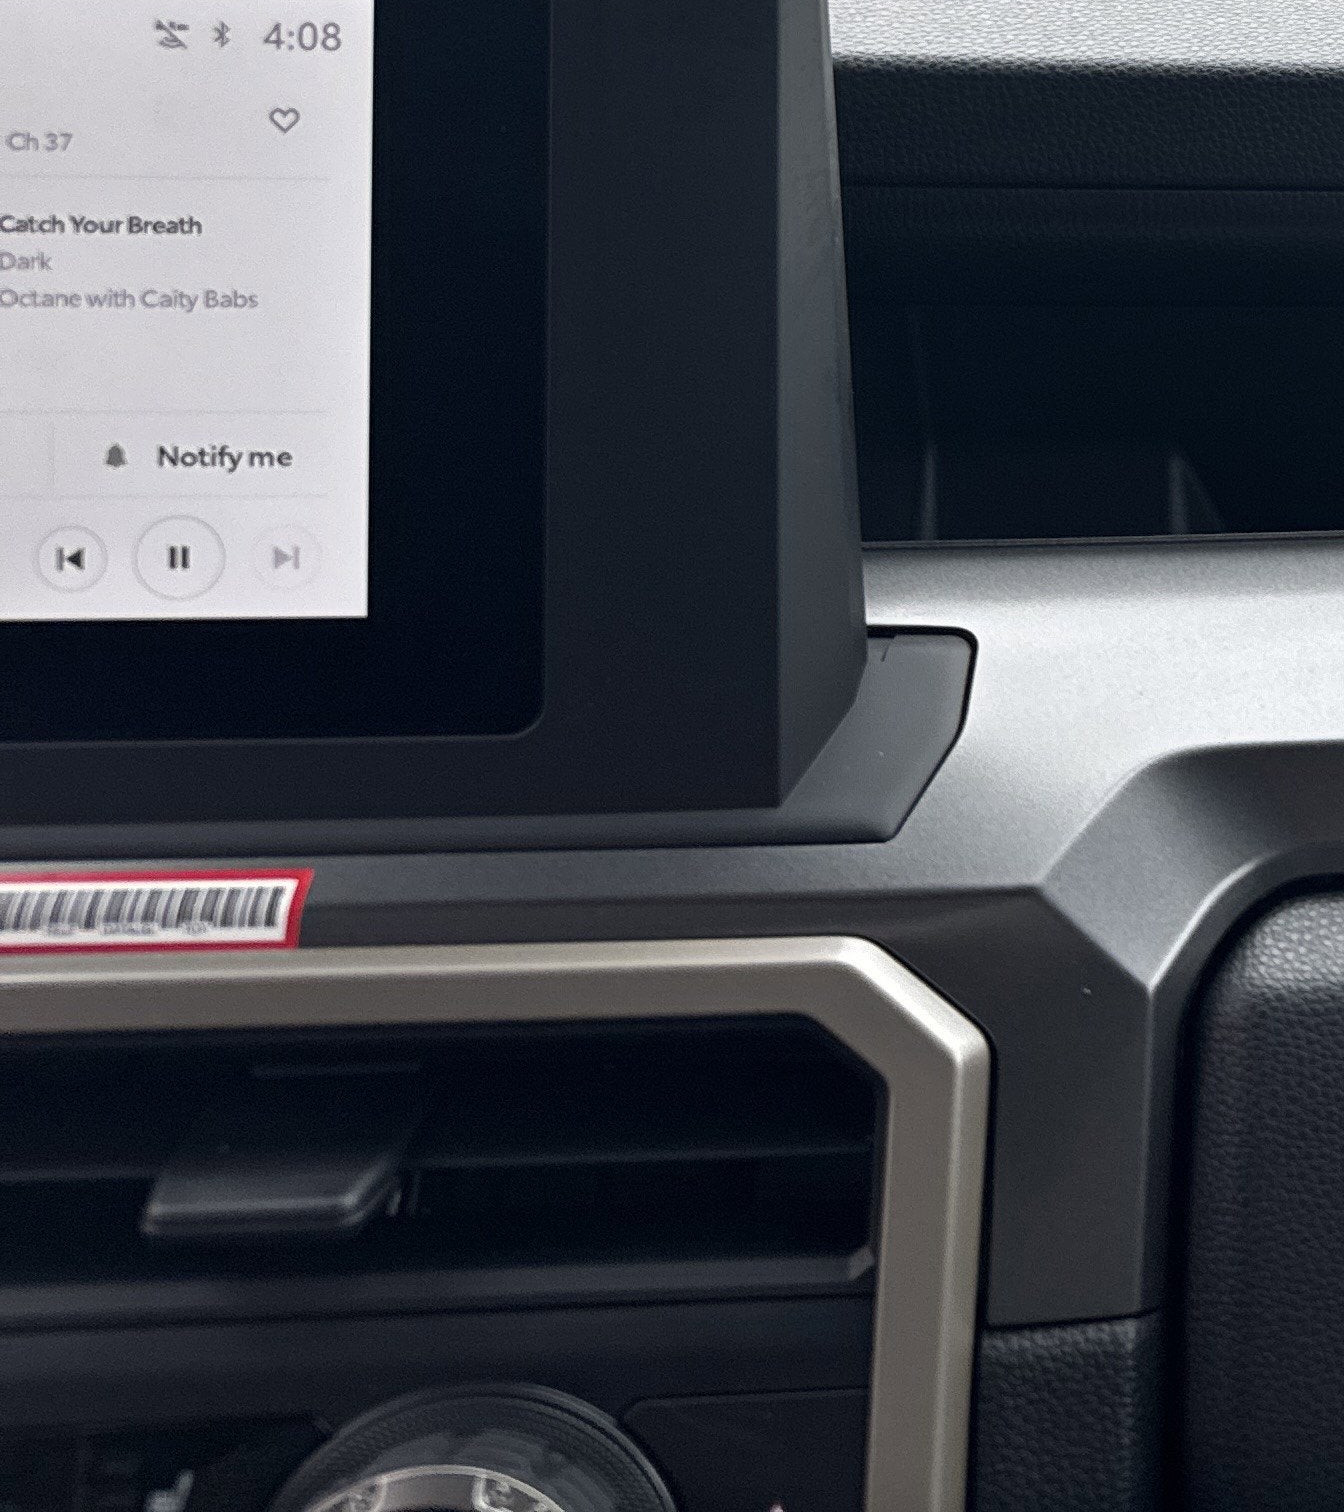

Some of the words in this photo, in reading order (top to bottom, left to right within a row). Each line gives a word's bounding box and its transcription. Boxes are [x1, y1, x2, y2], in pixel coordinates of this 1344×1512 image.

[264, 21, 342, 52] 4:08
[5, 131, 40, 152] Ch
[44, 131, 73, 152] 37
[0, 214, 66, 234] Catch
[68, 214, 124, 234] Your
[127, 214, 203, 235] Breath
[0, 251, 53, 271] Dark
[0, 289, 83, 309] Octane
[85, 288, 136, 308] with
[139, 290, 199, 313] Caity
[203, 289, 260, 309] Babs
[156, 445, 243, 473] Notify
[249, 449, 294, 468] me
